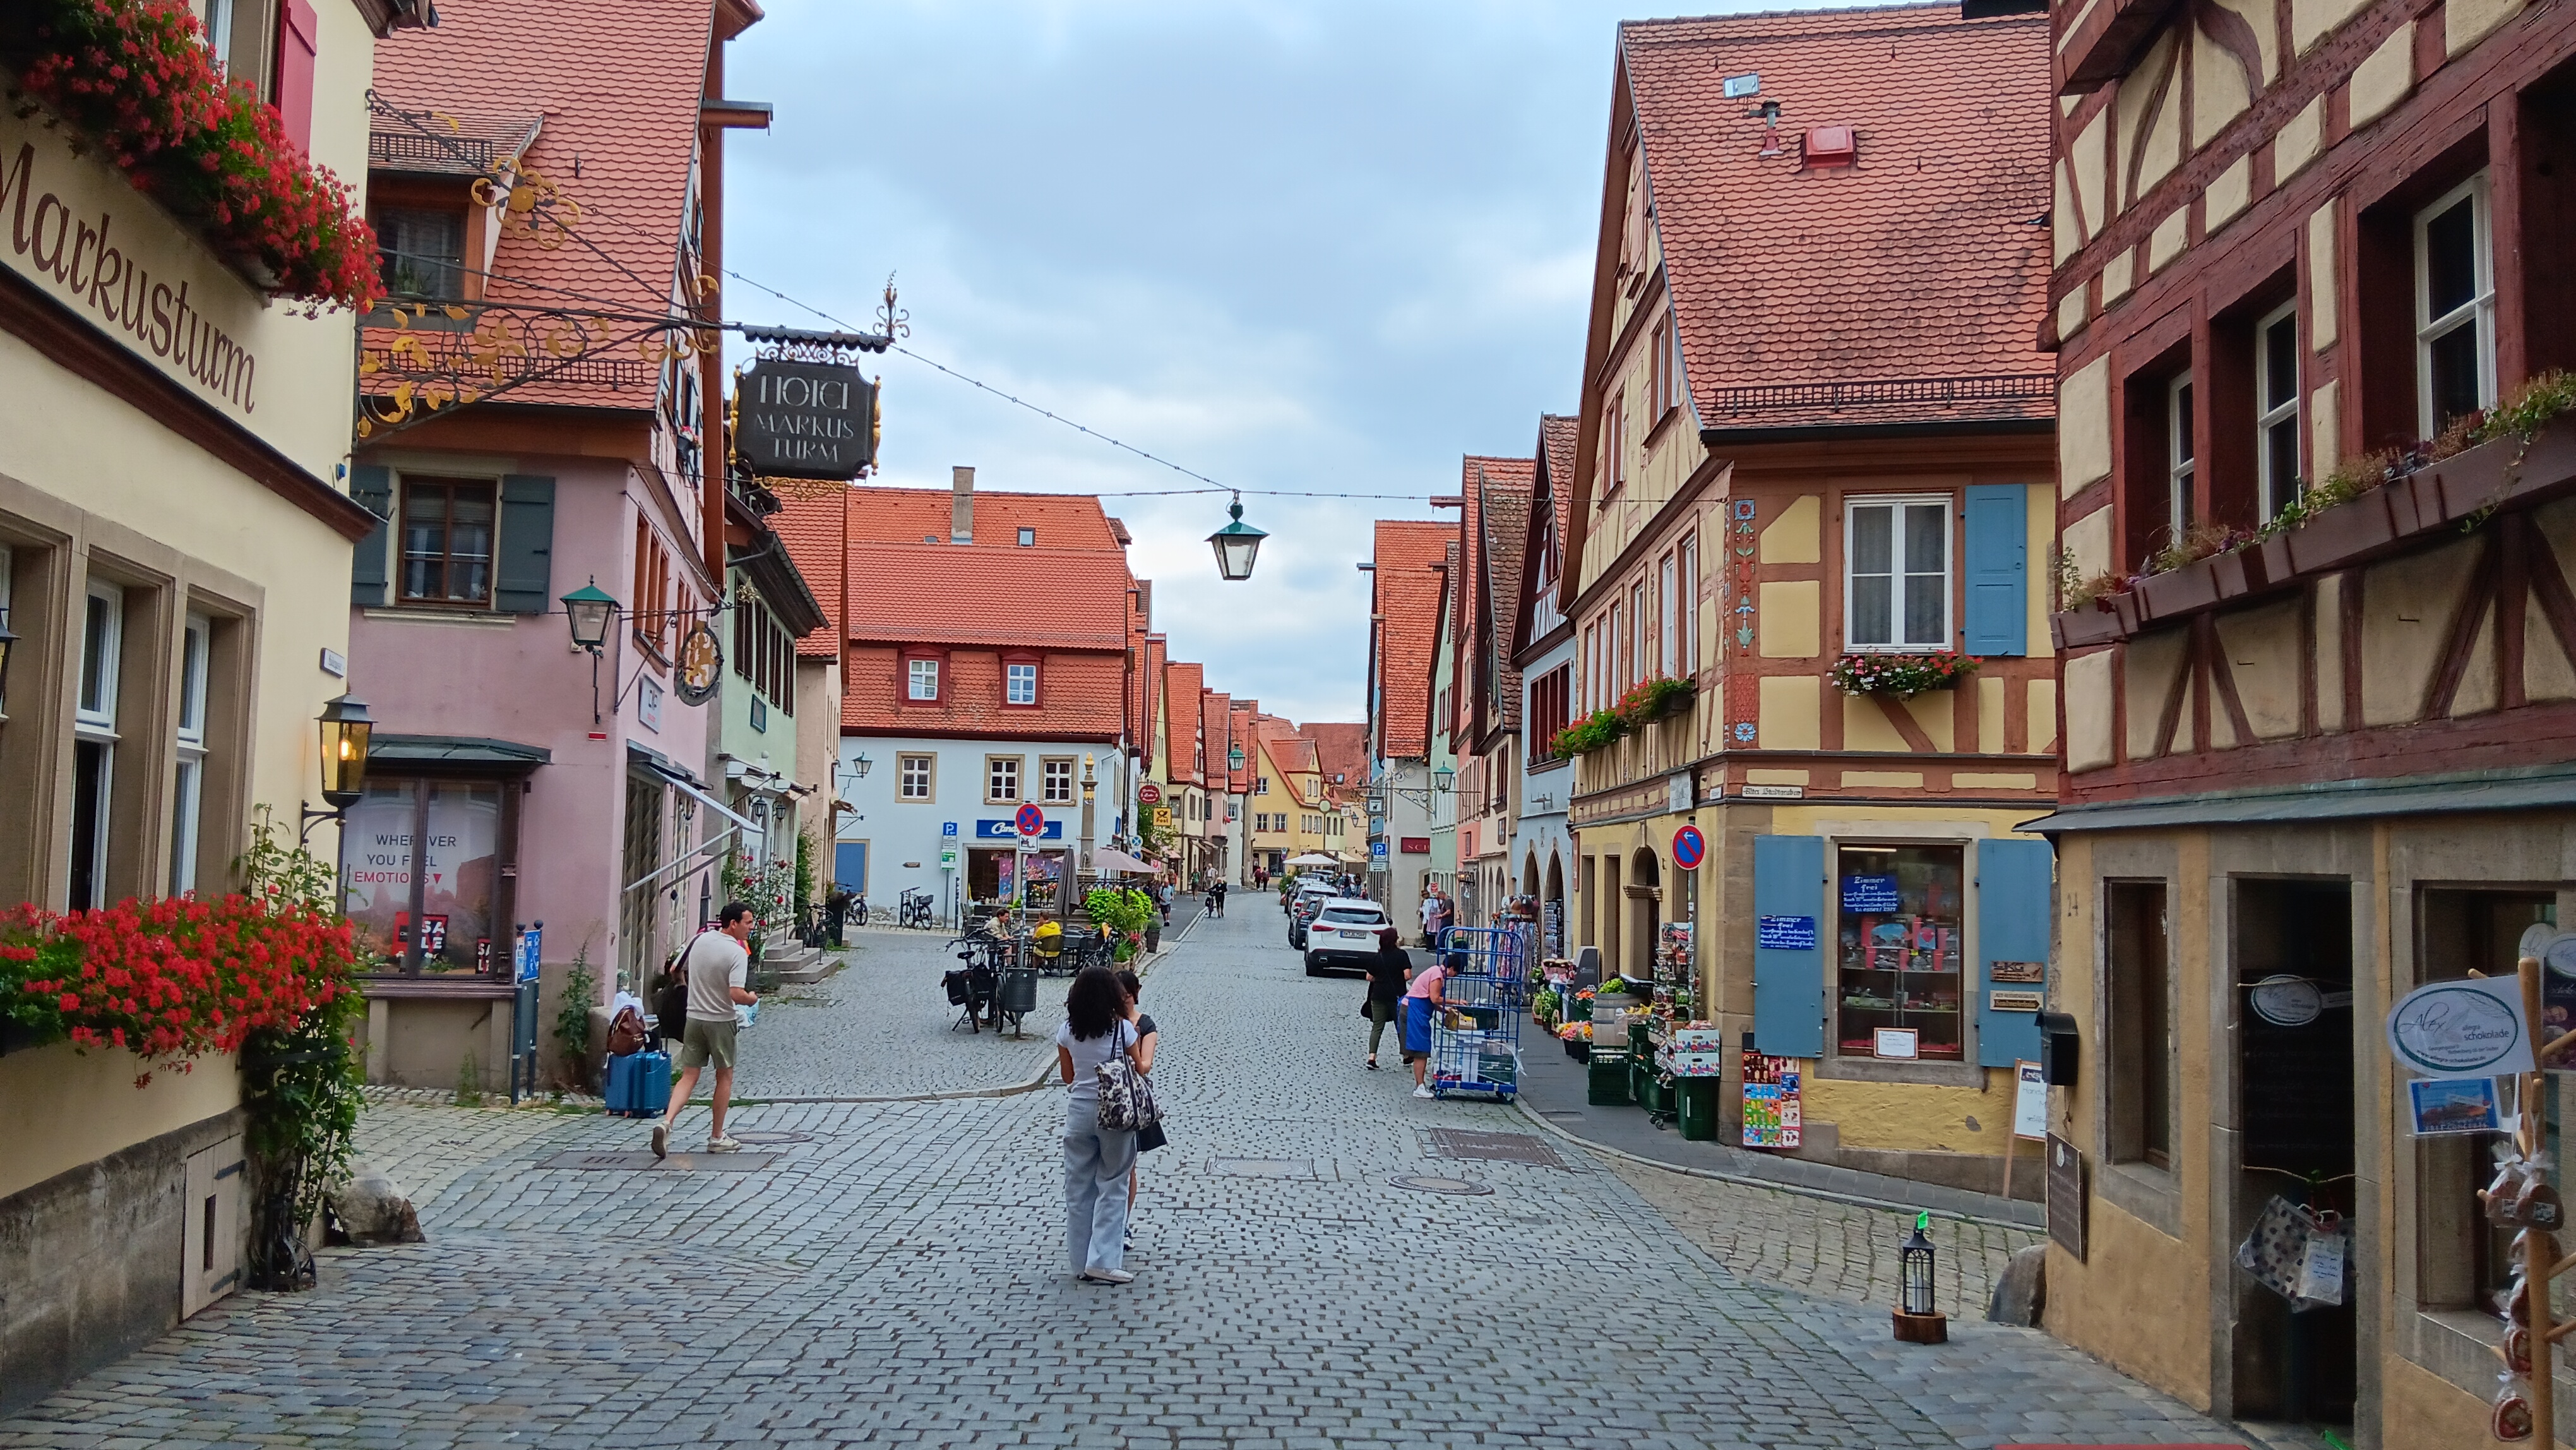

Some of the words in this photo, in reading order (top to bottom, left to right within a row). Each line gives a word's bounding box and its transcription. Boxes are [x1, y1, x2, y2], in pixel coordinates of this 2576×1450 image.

[756, 414, 854, 439] MARKUS
[773, 438, 838, 462] TURM
[946, 824, 954, 834] P
[376, 835, 456, 847] WHEVER
[1376, 845, 1383, 854] P
[367, 854, 396, 866] YOU
[402, 855, 437, 866] FL
[355, 872, 429, 884] EMOTIOS
[421, 920, 445, 934] SA
[421, 937, 443, 949] LE
[2399, 1002, 2449, 1038] Alex
[2464, 1028, 2510, 1041] schokolade
